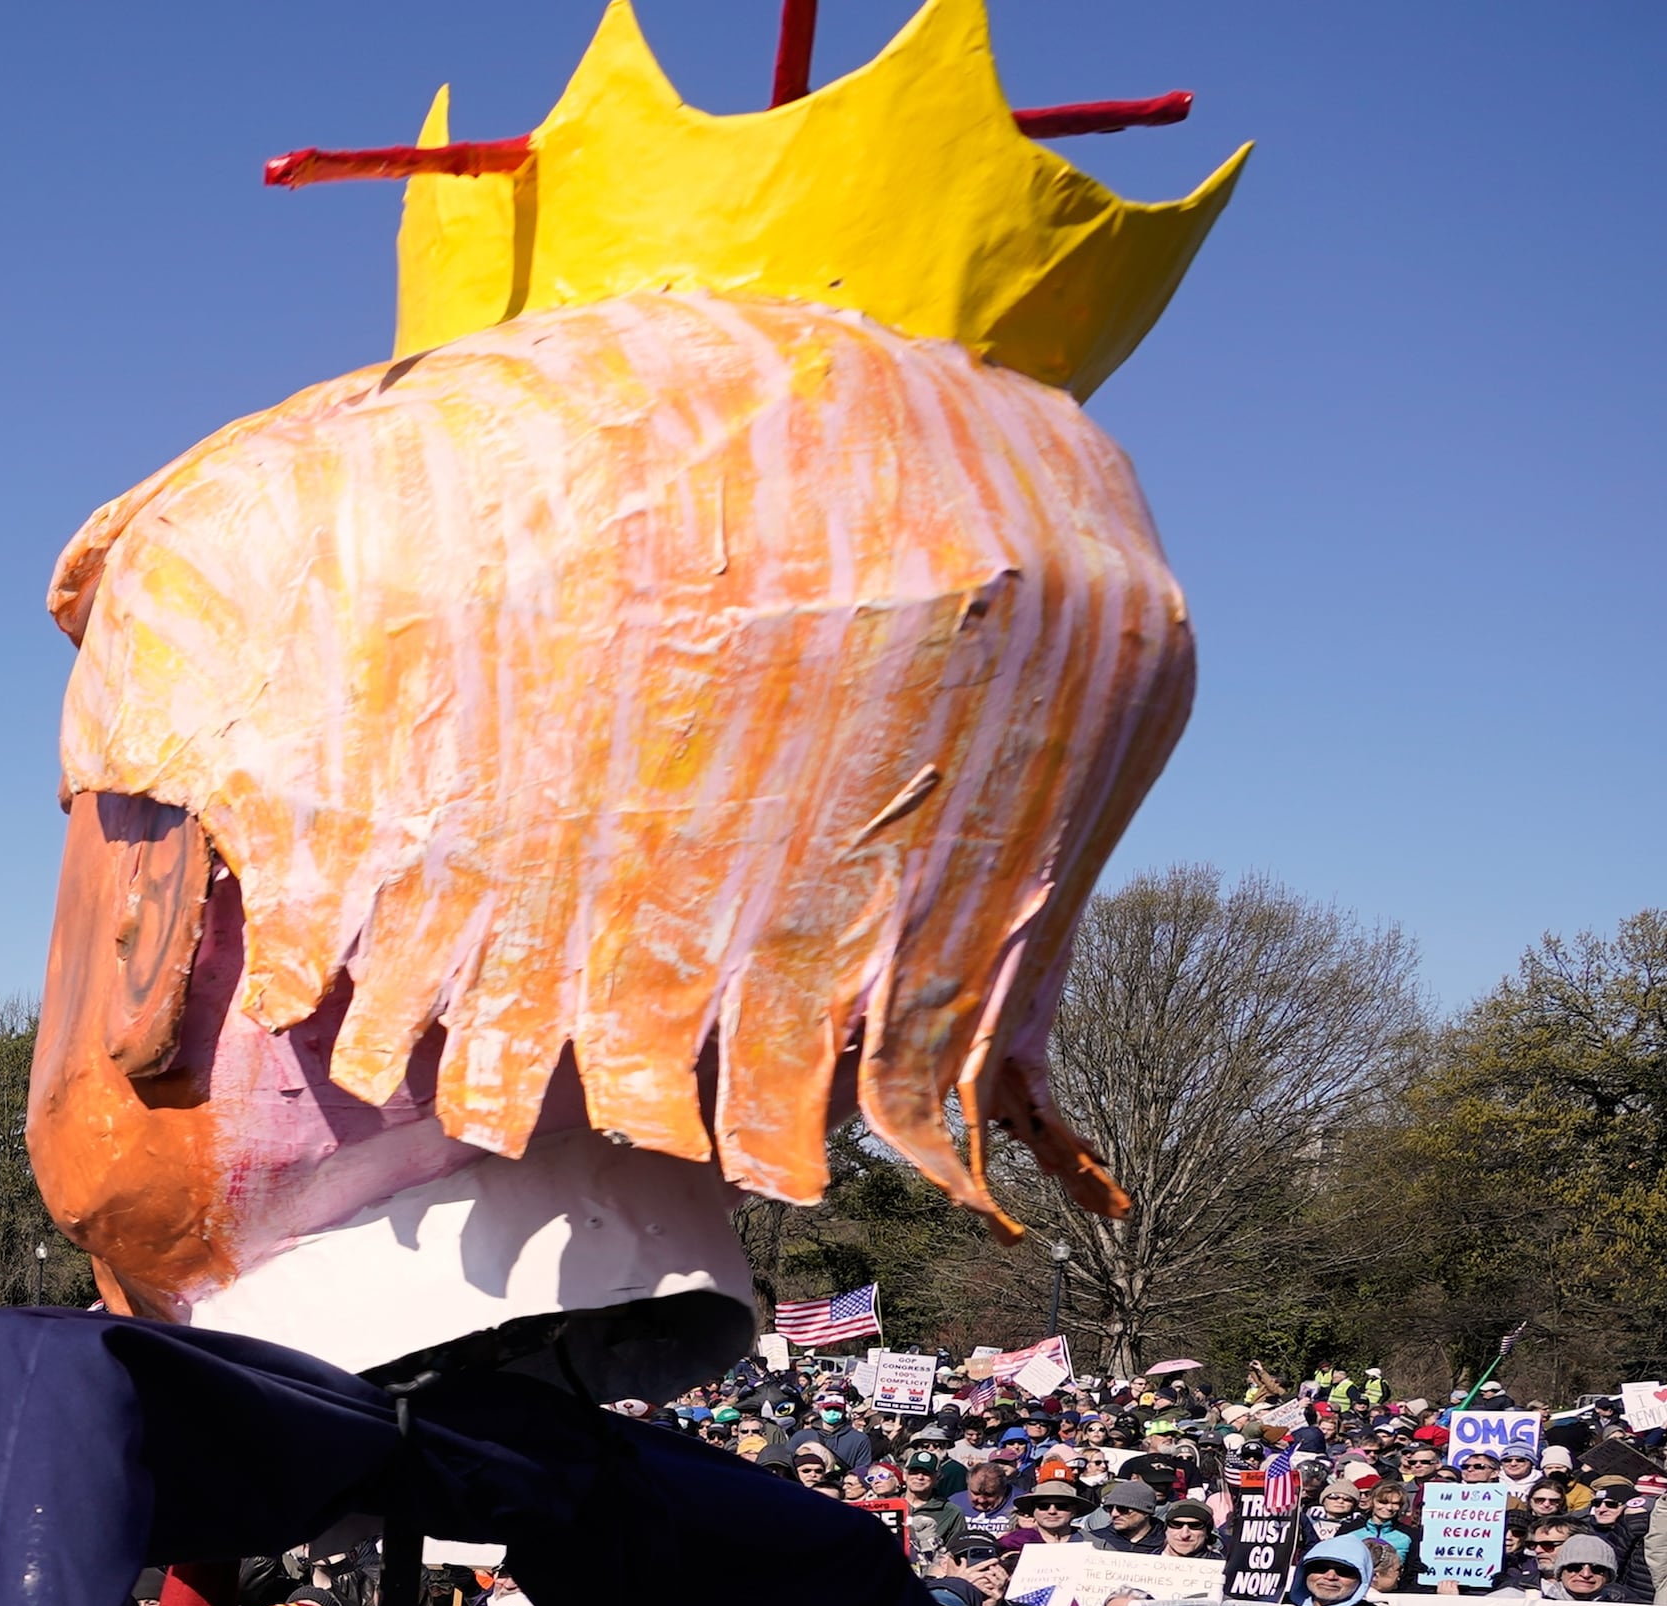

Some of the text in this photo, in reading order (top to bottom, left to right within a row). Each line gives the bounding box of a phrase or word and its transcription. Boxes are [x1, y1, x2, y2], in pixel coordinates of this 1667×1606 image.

[897, 1356, 919, 1364] GOP
[882, 1362, 931, 1373] CONGRESS
[894, 1371, 917, 1379] 100%
[879, 1377, 929, 1388] COMPLICIT
[1628, 1404, 1667, 1429] DEMO
[1455, 1416, 1539, 1445] OMG
[1460, 1489, 1492, 1501] USA
[1454, 1508, 1502, 1522] PEOPLE
[1241, 1520, 1290, 1543] MUST
[1443, 1526, 1491, 1539] REIGN
[1249, 1546, 1275, 1568] GO
[1153, 1562, 1195, 1575] OVERLY
[1086, 1570, 1198, 1587] THE BOUNDARIES OF
[1230, 1572, 1280, 1596] NOW!
